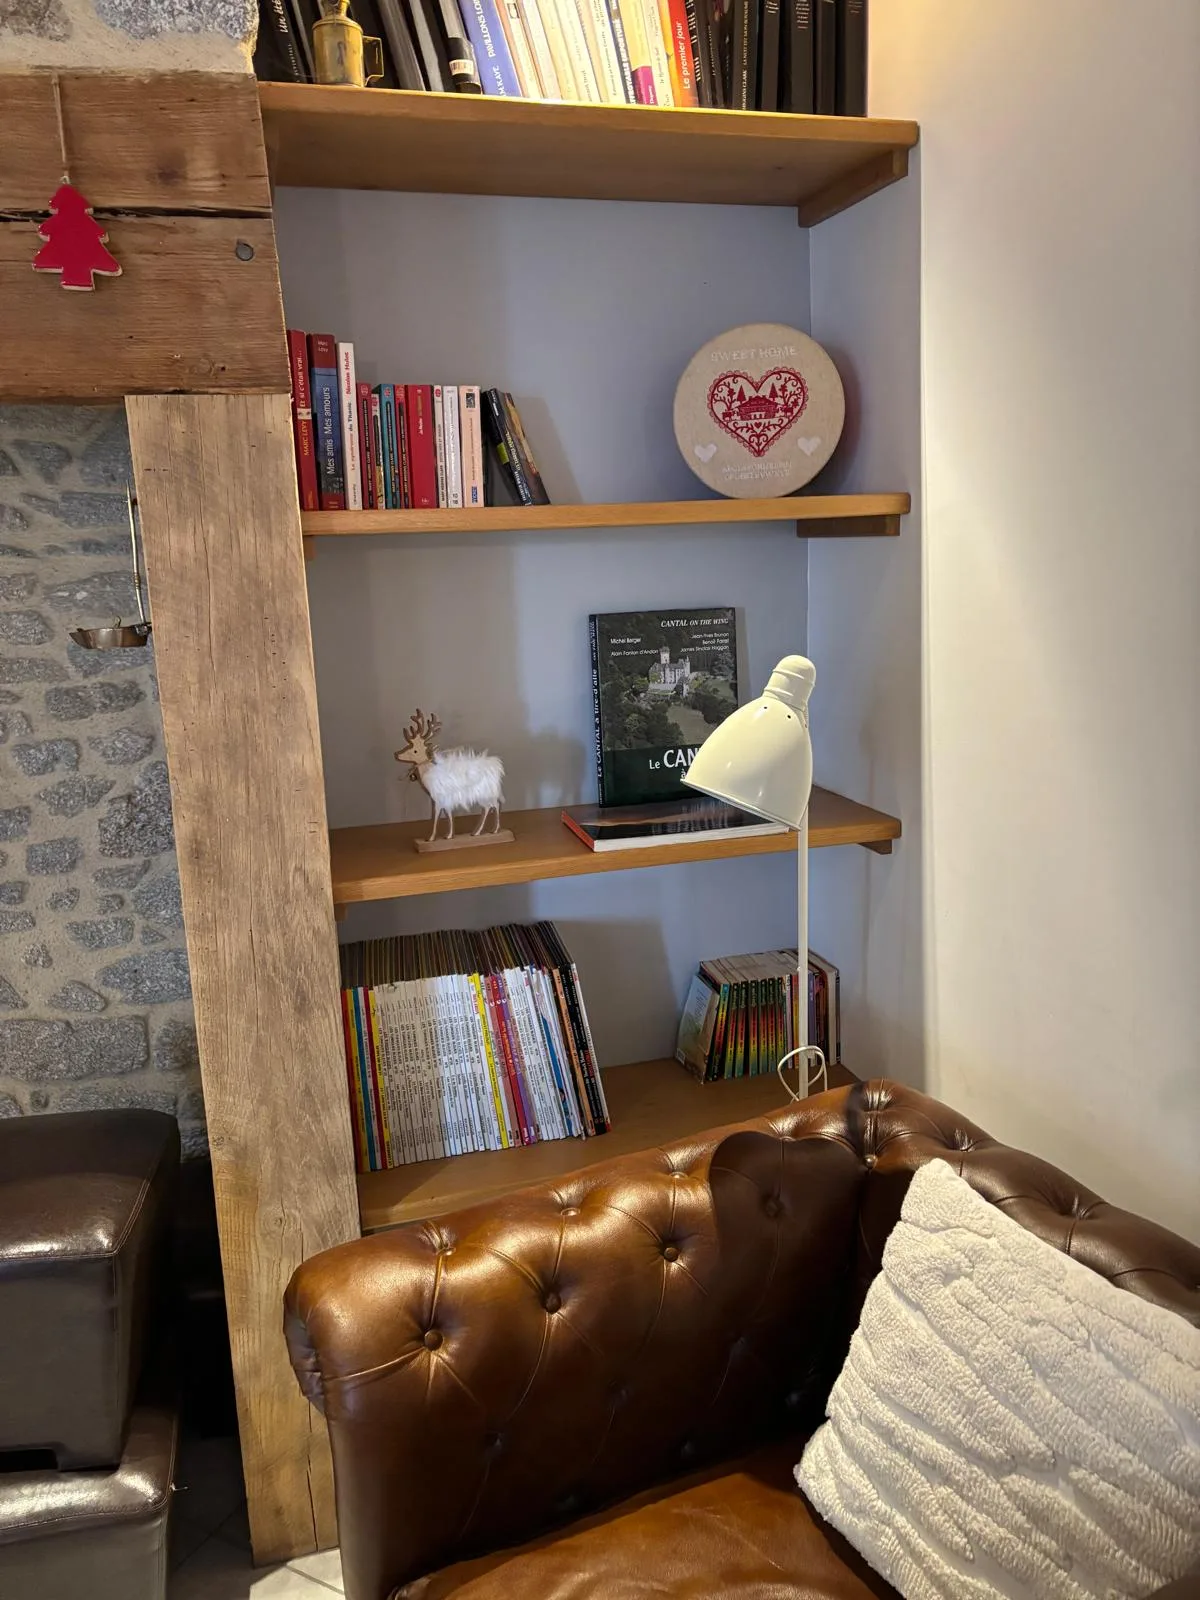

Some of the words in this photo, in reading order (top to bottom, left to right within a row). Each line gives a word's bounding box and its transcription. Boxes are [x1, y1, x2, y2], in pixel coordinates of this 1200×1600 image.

[276, 15, 288, 33] Un
[674, 20, 684, 39] jour
[476, 14, 497, 57] PAVILLONS
[677, 40, 689, 75] premier
[711, 348, 754, 362] SWEET
[759, 345, 798, 358] HOME
[321, 386, 331, 416] amours
[323, 417, 332, 434] Mes
[324, 438, 333, 456] amis
[326, 457, 335, 474] Mes
[660, 619, 688, 628] CANTAL
[649, 759, 660, 769] Le
[663, 747, 699, 768] CAN
